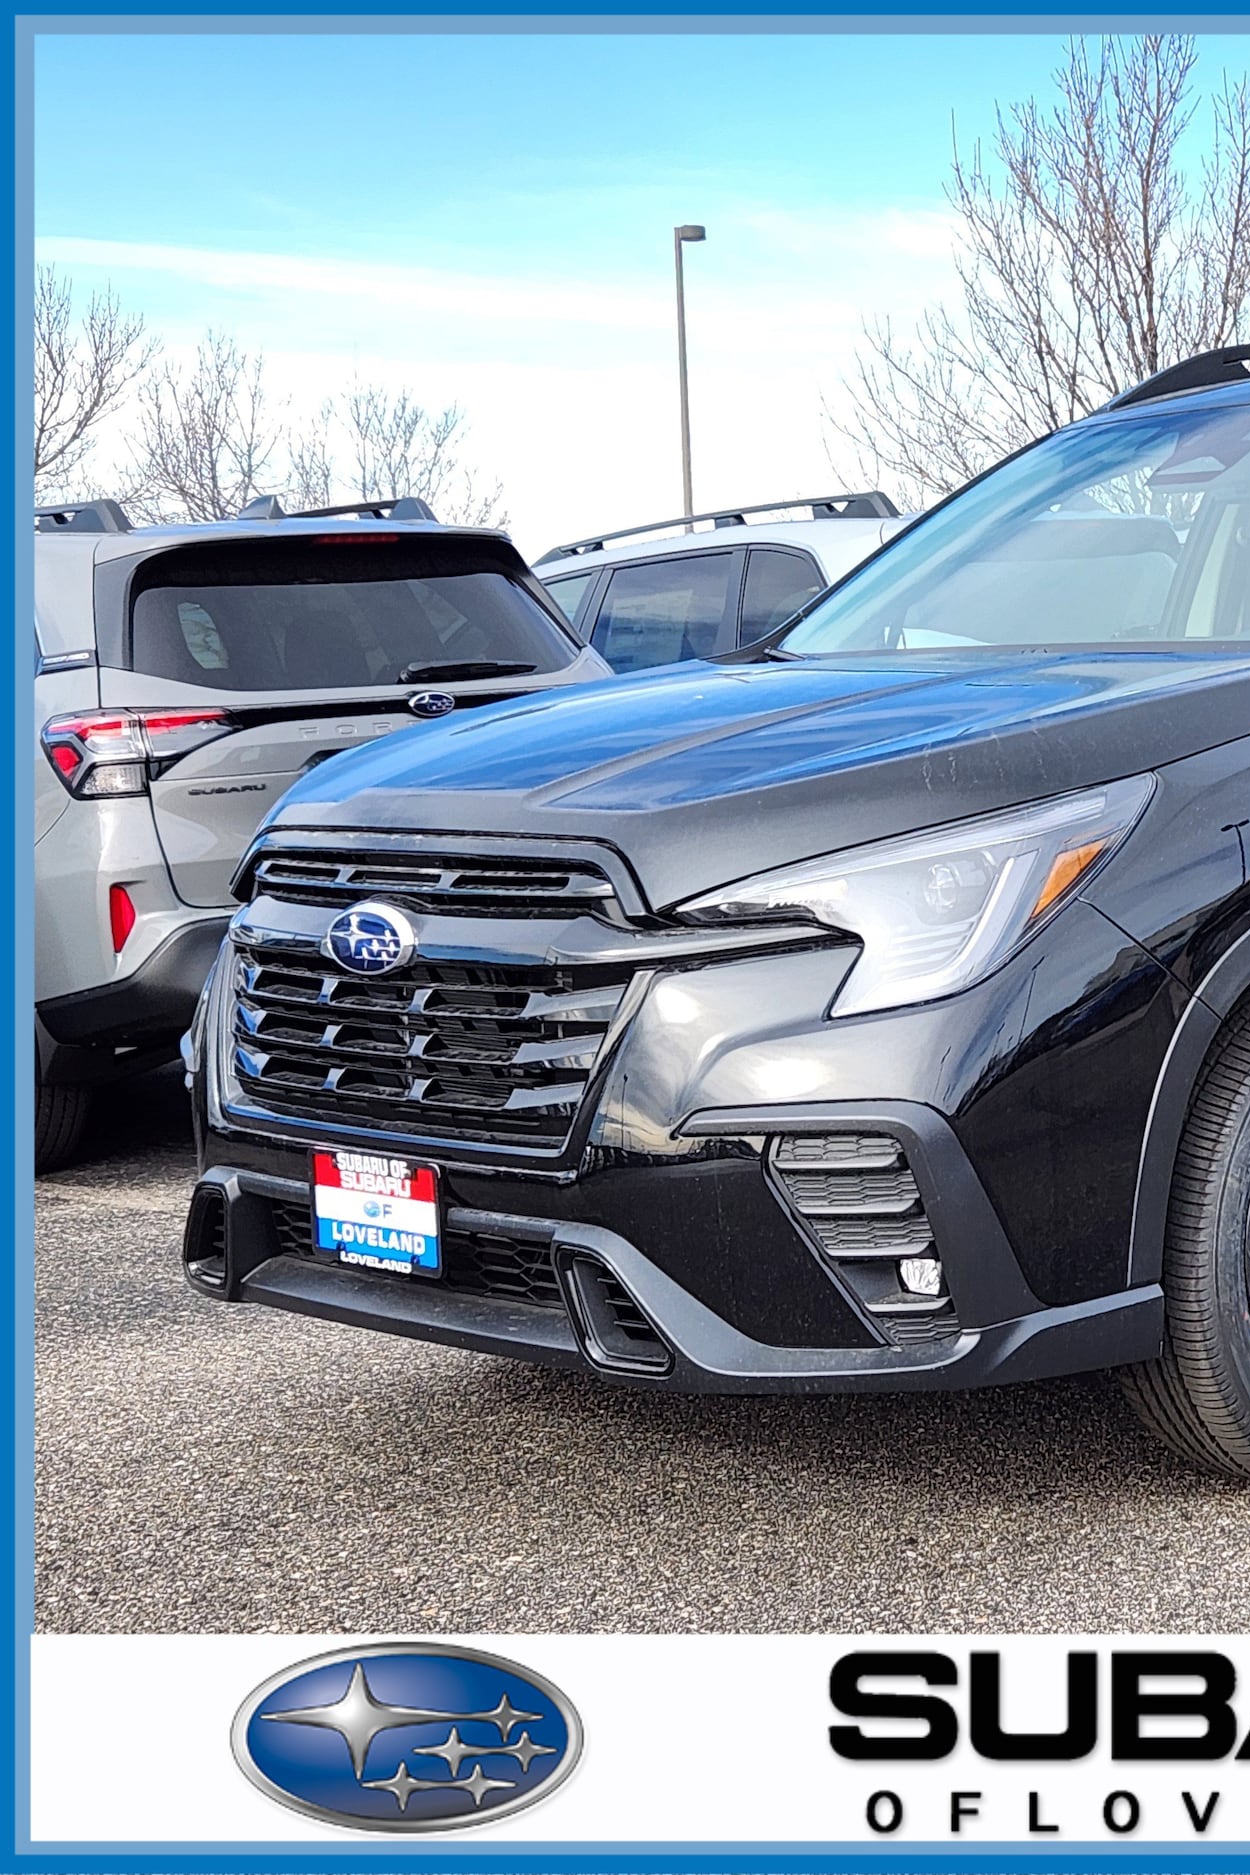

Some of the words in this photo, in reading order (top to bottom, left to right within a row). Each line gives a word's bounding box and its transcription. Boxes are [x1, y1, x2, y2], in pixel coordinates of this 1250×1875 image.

[187, 783, 266, 796] SUBARU
[336, 1152, 389, 1177] SUBARU
[389, 1159, 410, 1179] OF
[340, 1170, 412, 1198] SUBARU
[331, 1221, 426, 1255] LOVELAND
[340, 1250, 412, 1274] LOVELAND
